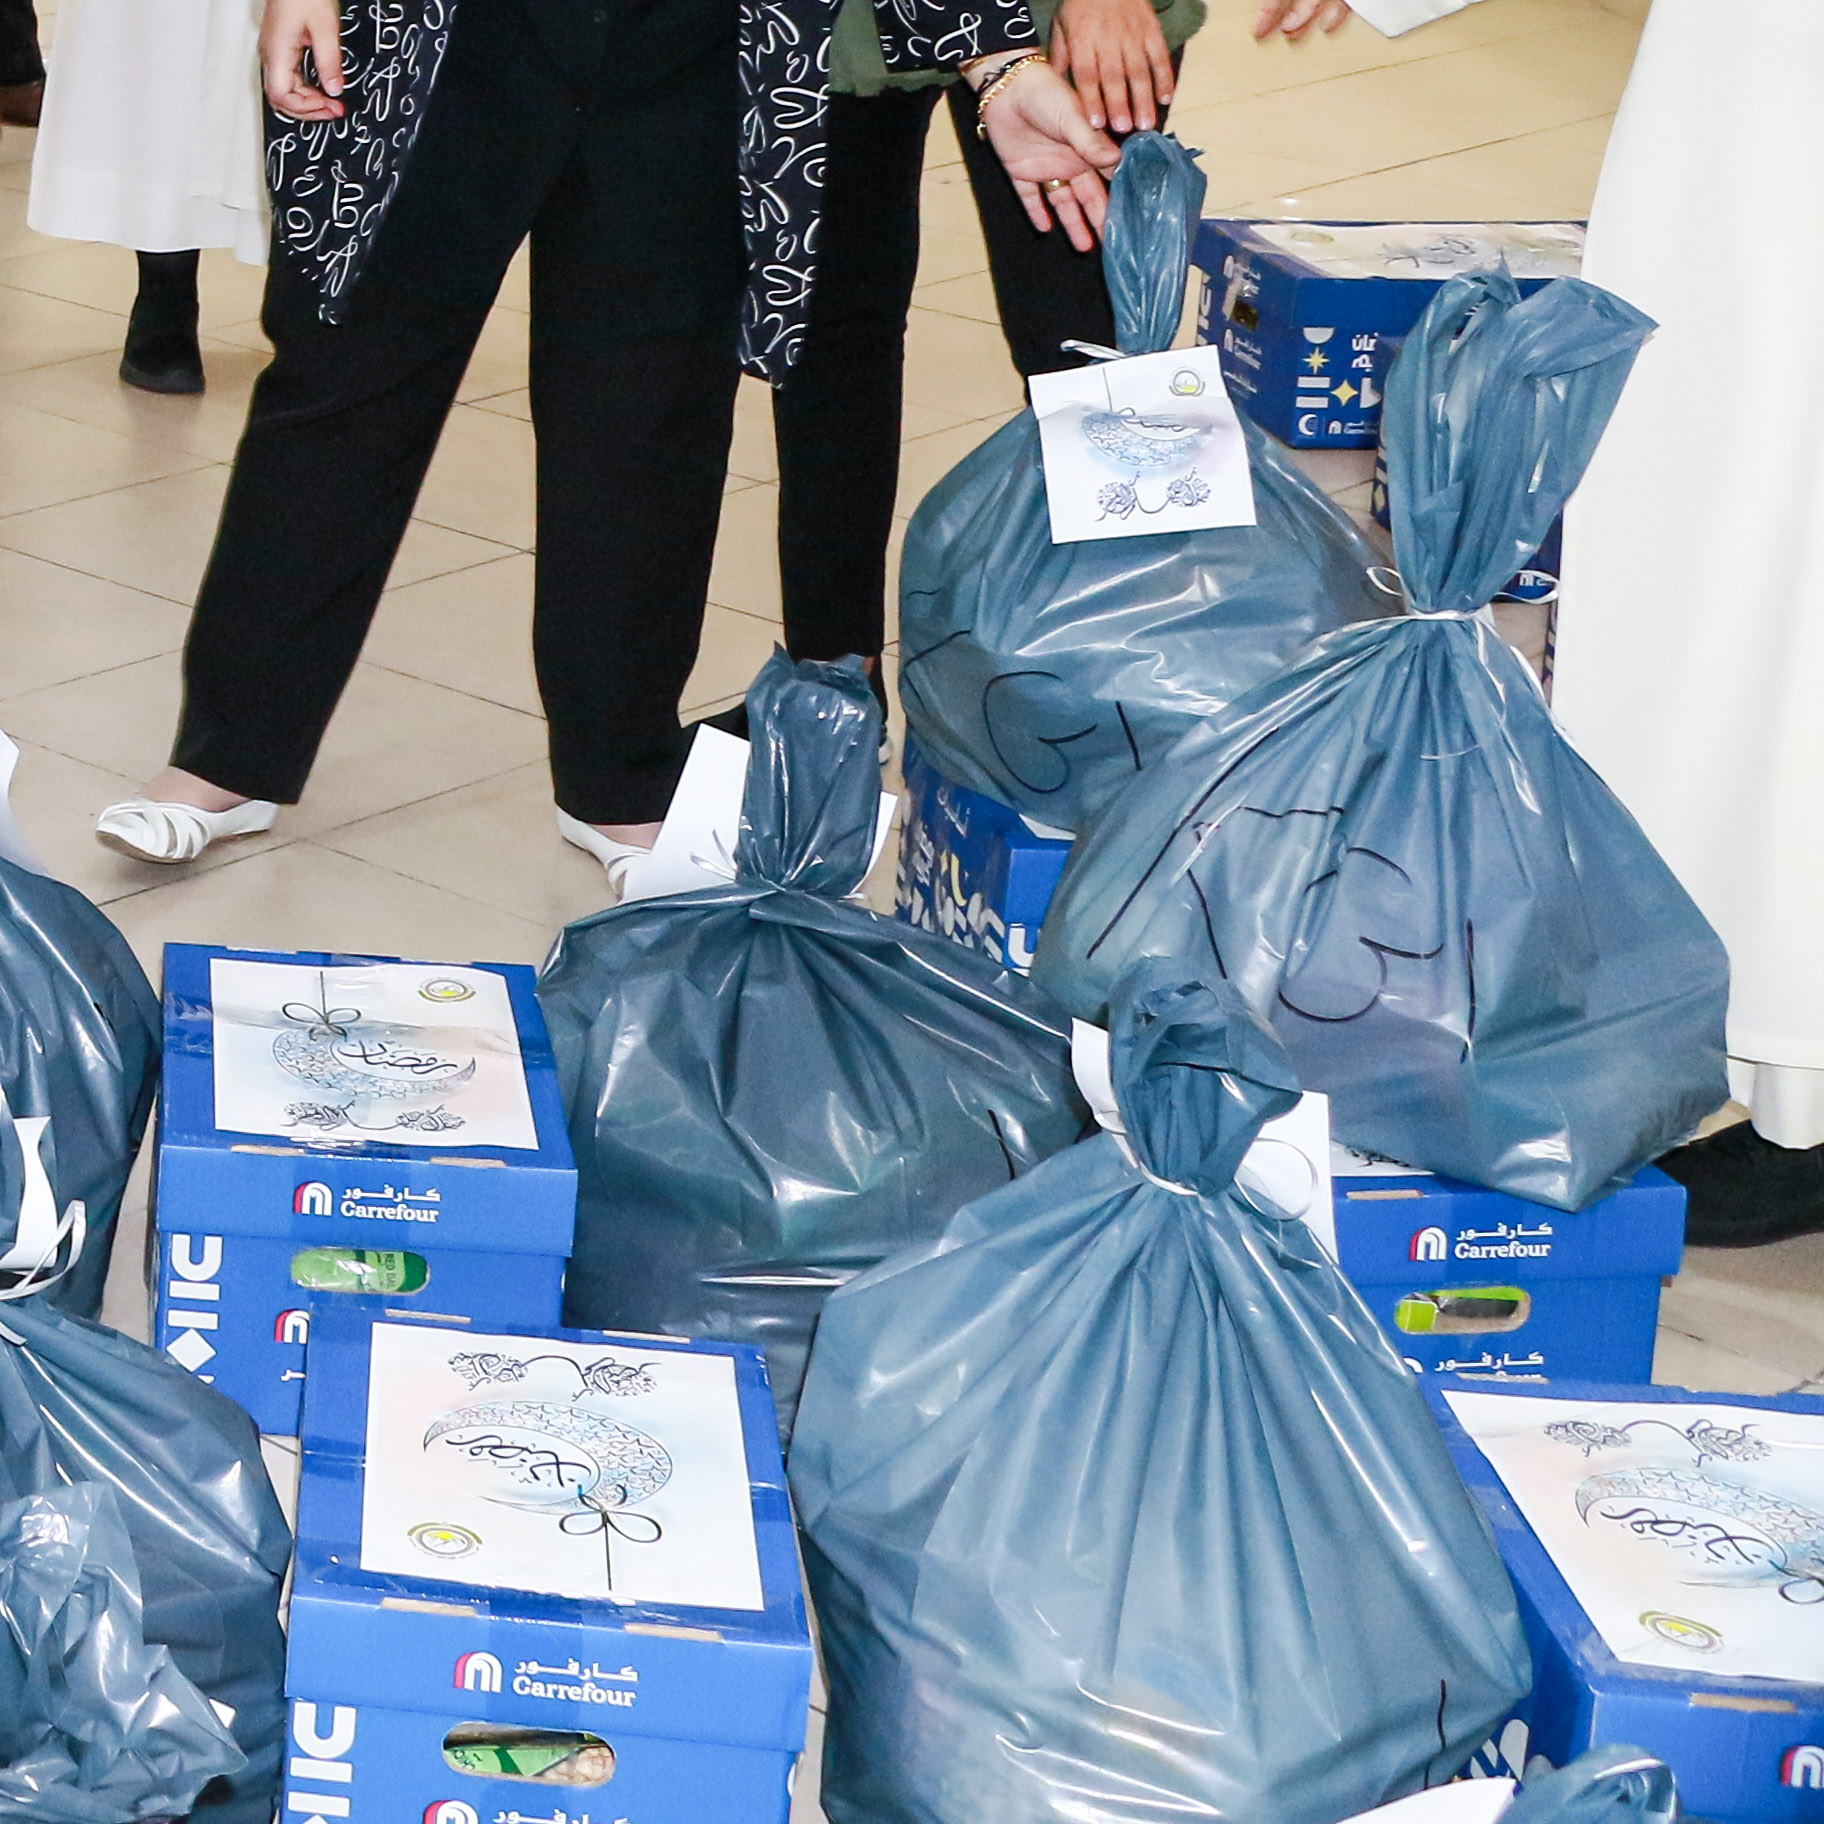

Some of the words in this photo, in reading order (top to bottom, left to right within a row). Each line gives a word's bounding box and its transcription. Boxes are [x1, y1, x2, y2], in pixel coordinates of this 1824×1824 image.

[342, 1184, 442, 1204] كارفور
[340, 1201, 441, 1224] Carrefour
[1455, 1222, 1553, 1241] كارفور
[1454, 1241, 1552, 1259] Carrefour
[1434, 1351, 1545, 1372] كارفور
[513, 1657, 640, 1683] كارفور
[512, 1675, 638, 1708] Carrefour
